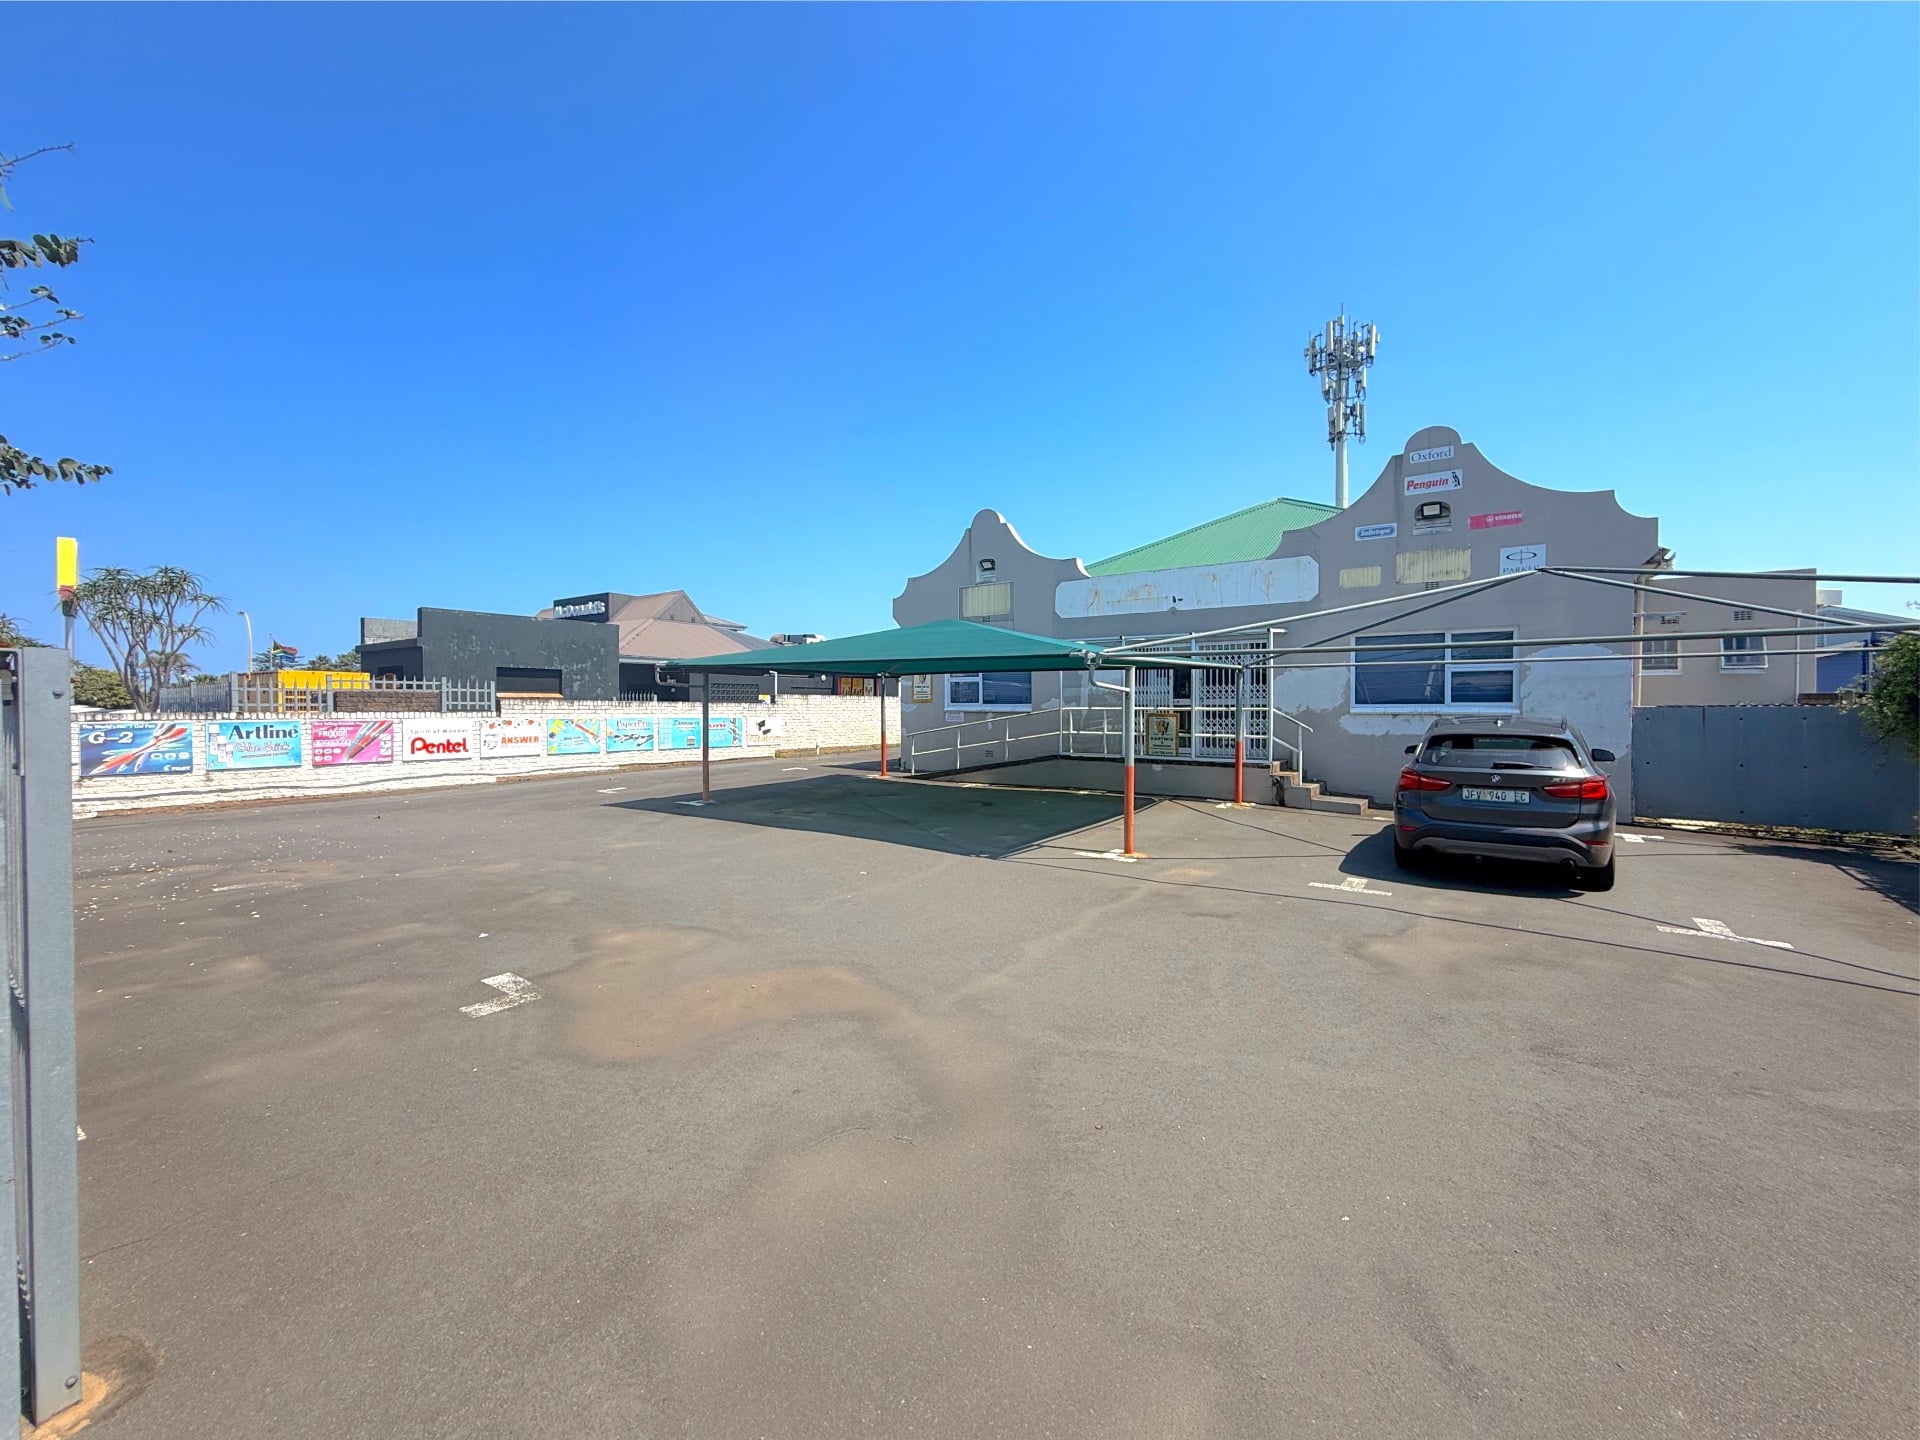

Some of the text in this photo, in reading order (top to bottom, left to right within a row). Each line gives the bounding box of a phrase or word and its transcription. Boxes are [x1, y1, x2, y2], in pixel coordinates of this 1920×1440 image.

[1411, 447, 1452, 462] Oxford
[1406, 478, 1449, 491] Penguin
[554, 600, 606, 619] McDonald's
[88, 731, 134, 744] G-2
[229, 724, 298, 740] Artline
[410, 737, 469, 754] Pentel
[501, 735, 539, 745] ANSWER
[1464, 789, 1482, 800] JFV
[1489, 791, 1507, 801] 940
